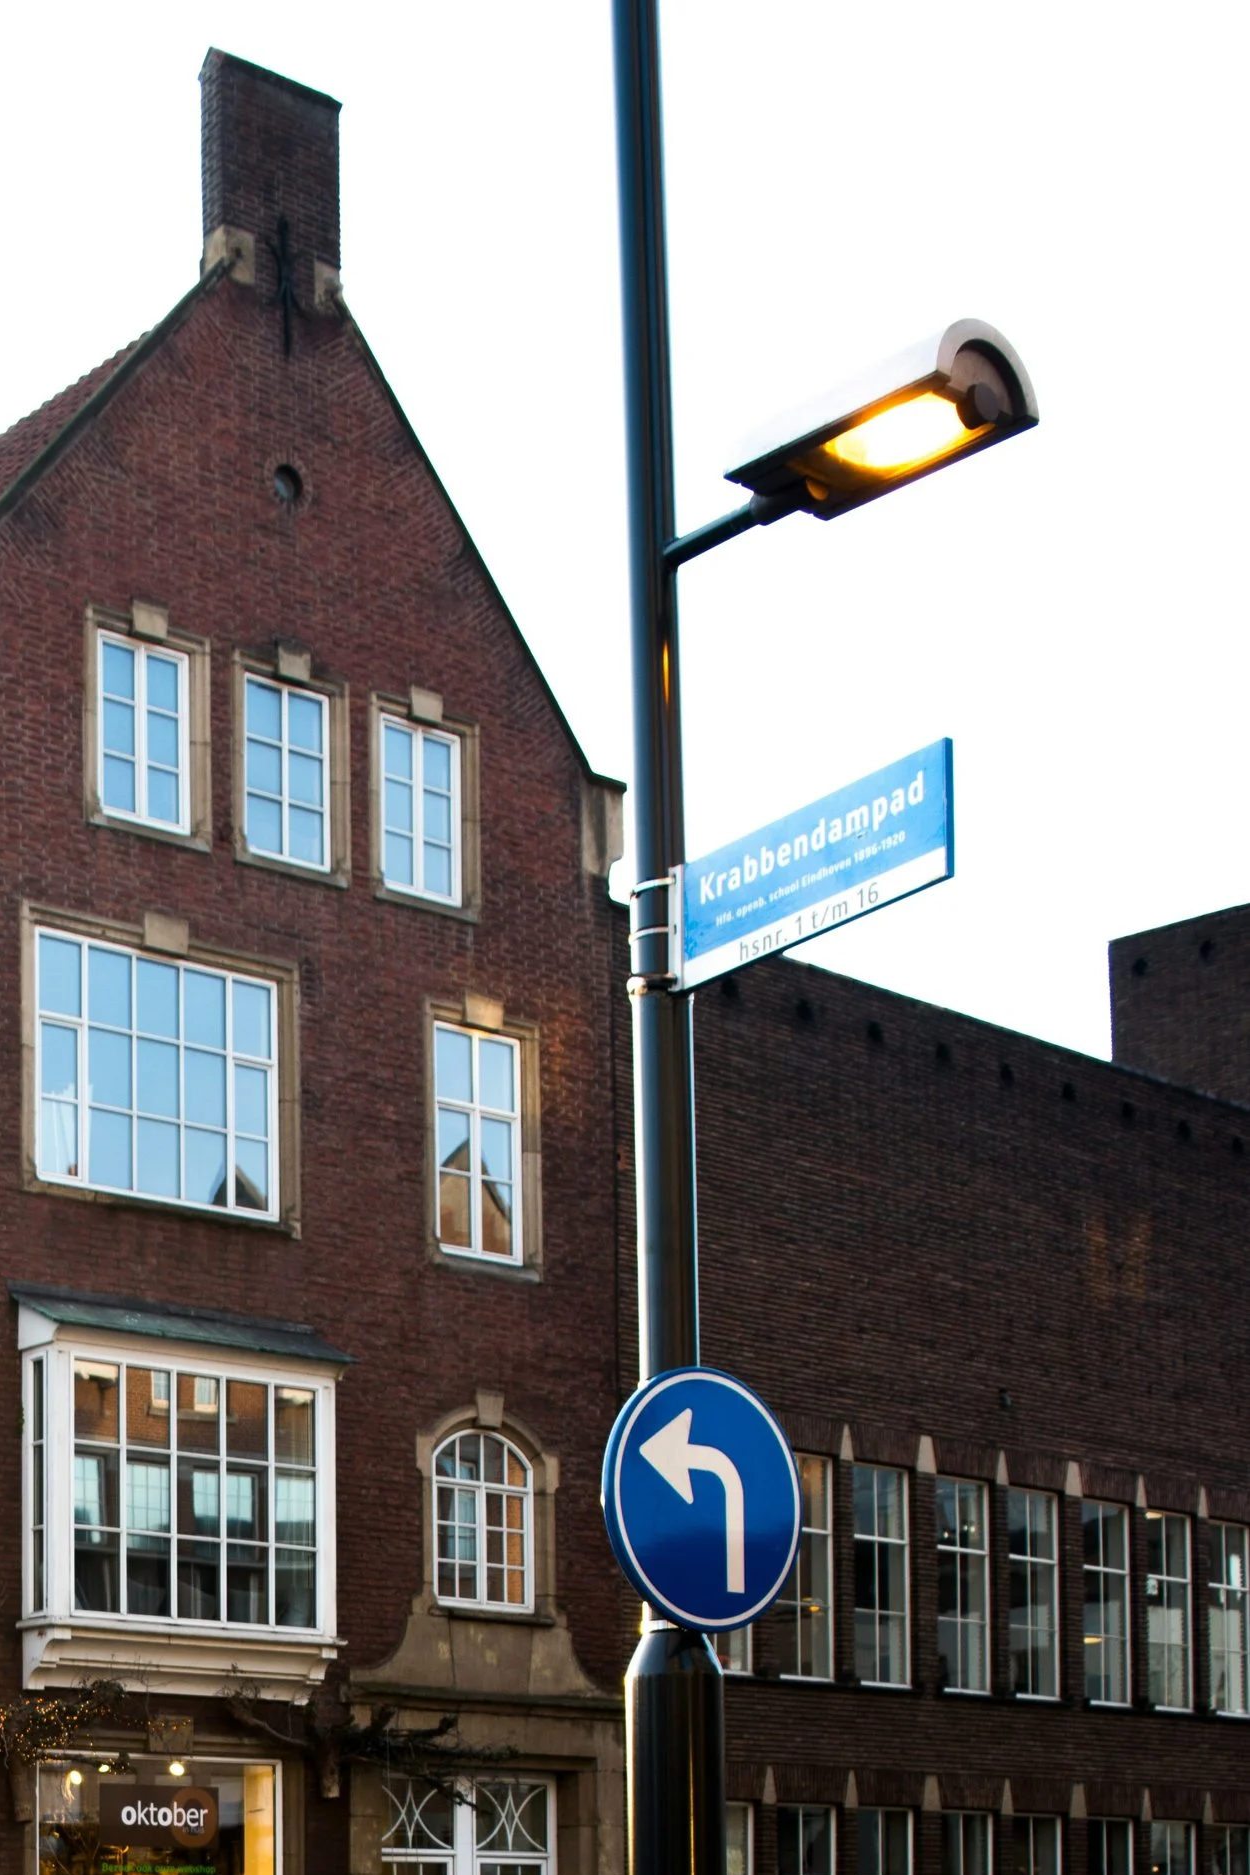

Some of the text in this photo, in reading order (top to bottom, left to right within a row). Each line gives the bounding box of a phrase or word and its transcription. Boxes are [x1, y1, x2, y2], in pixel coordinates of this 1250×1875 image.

[700, 770, 924, 905] Krabbendampad
[736, 897, 768, 918] openb.
[768, 879, 799, 902] school
[801, 857, 851, 887] Eindhoven
[739, 882, 880, 962] hsnr. 1 t/m 16
[121, 1800, 208, 1827] oktober
